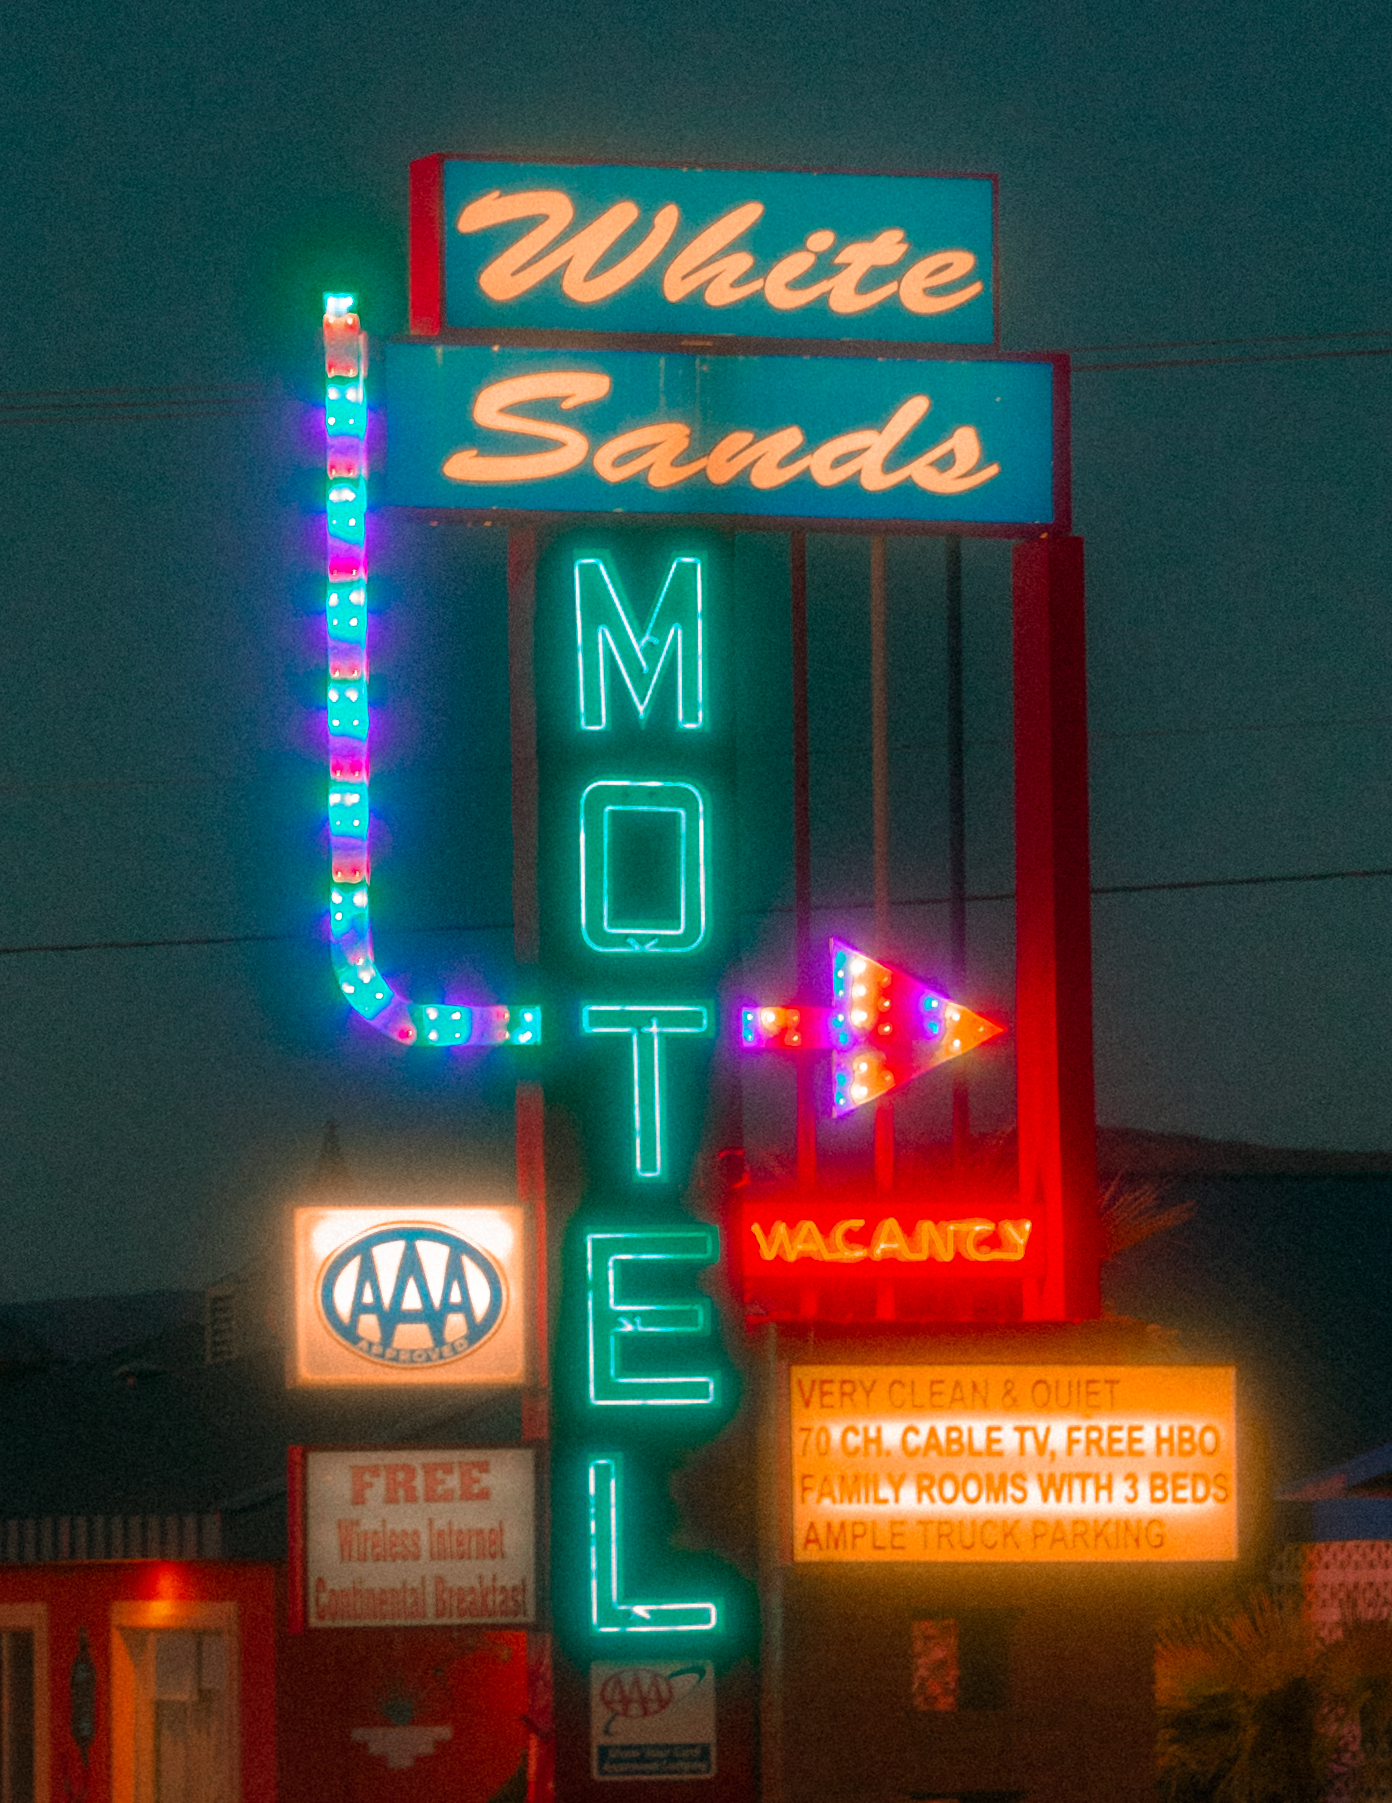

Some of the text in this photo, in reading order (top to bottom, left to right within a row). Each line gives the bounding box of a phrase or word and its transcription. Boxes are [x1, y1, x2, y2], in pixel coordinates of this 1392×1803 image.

[457, 190, 983, 314] White
[442, 371, 1000, 494] Sands
[573, 553, 719, 1632] MOTEL
[751, 1218, 1032, 1262] VACANCY
[334, 1227, 488, 1350] AAA
[357, 1337, 469, 1363] APPROVED
[798, 1379, 1120, 1409] VERY CLEAN & QUIET
[800, 1424, 1221, 1462] 70 CH. CABLE TV, FREE HBO
[350, 1460, 490, 1506] FREE
[800, 1471, 1230, 1504] FAMILY ROOMS WITH 3 BEDS
[337, 1517, 505, 1563] Wireless Internet
[803, 1518, 1166, 1551] AMPLE TRUCK PARKING
[435, 1574, 527, 1618] Breakfast
[604, 1670, 671, 1717] AAA
